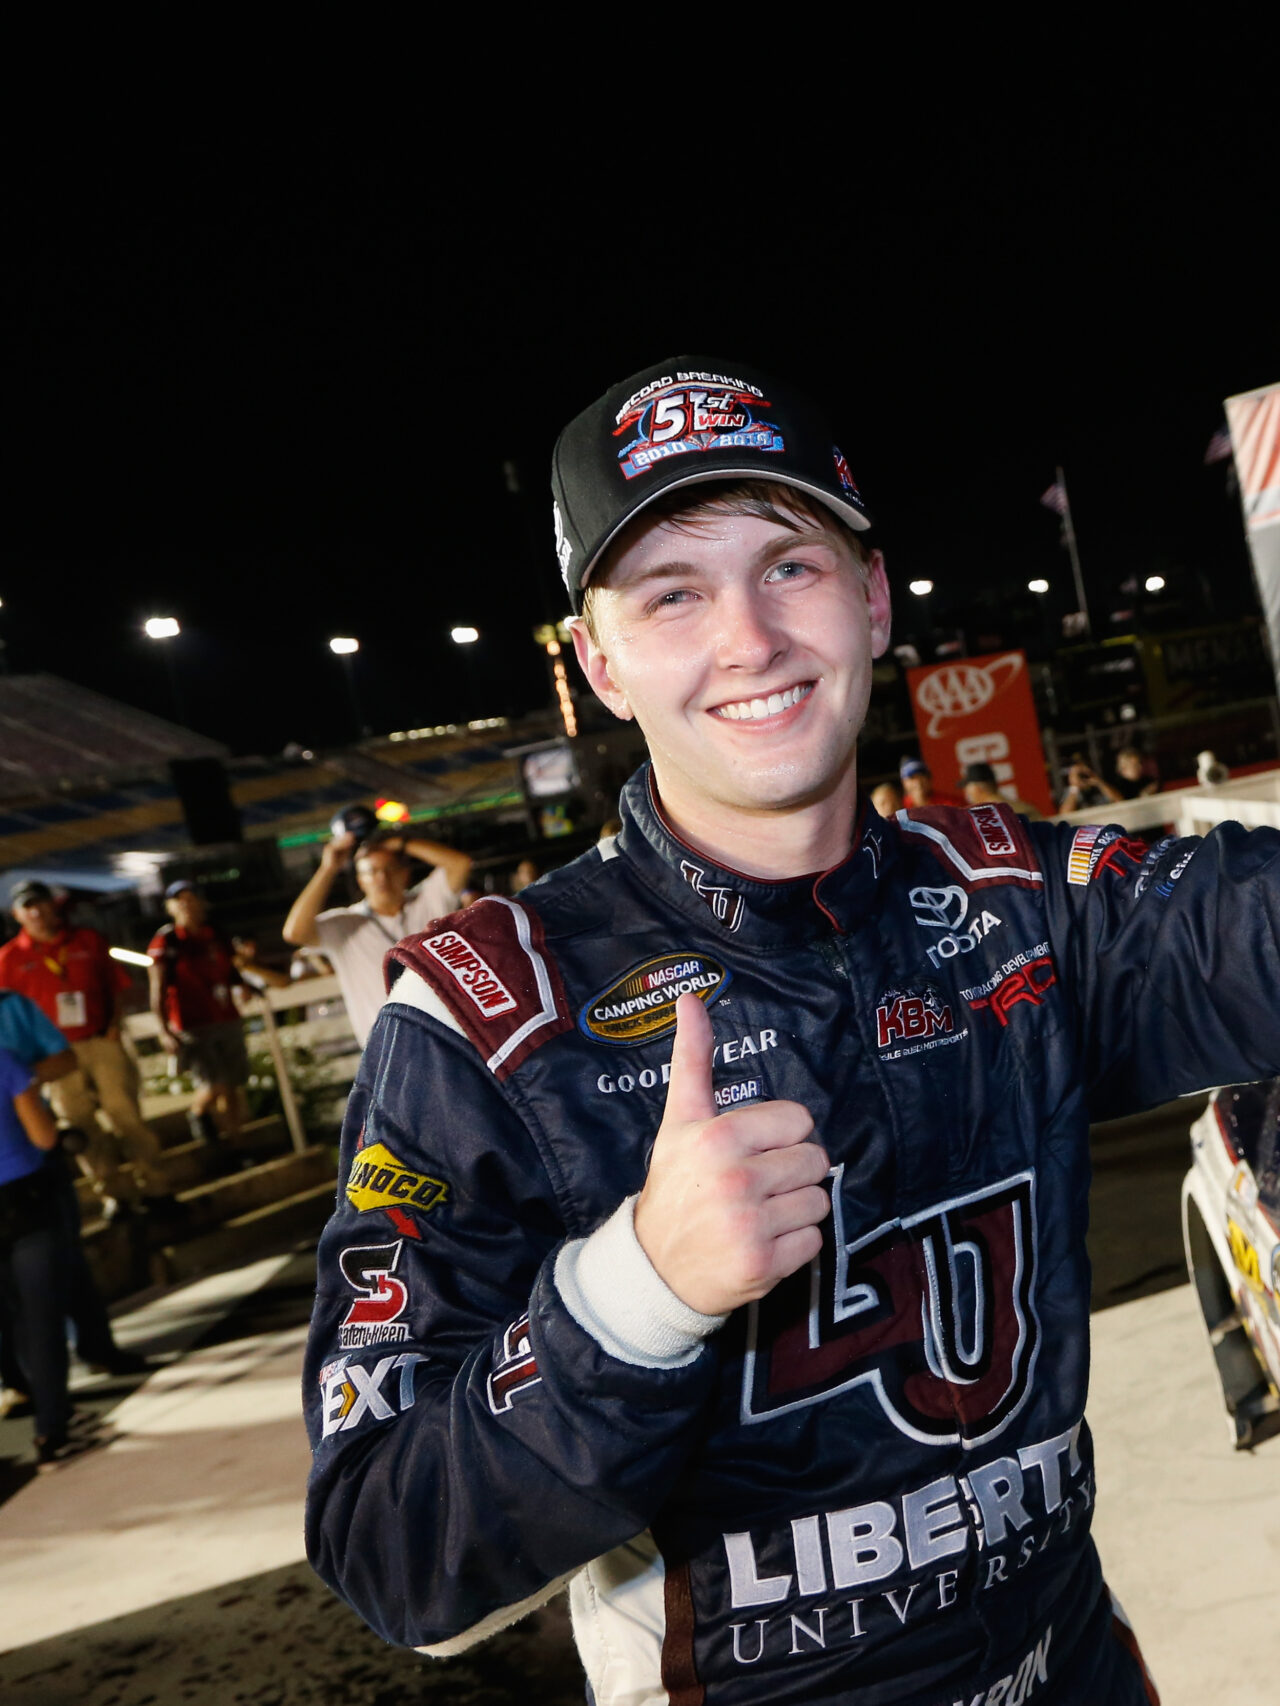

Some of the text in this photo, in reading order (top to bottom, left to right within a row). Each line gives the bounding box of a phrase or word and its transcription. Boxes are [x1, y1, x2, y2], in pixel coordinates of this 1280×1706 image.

[615, 371, 764, 425] RECORD BREAKING
[698, 413, 745, 427] WIN
[634, 441, 687, 466] 2010
[922, 664, 992, 713] AAA
[926, 910, 1002, 969] TOOTA
[429, 934, 510, 1011] SIMPSON
[594, 989, 664, 1020] CAMPING
[662, 972, 721, 999] WORLD
[648, 960, 700, 989] NASCAR
[876, 996, 954, 1048] KBM
[714, 1080, 757, 1106] ASCAR
[348, 1161, 443, 1206] UNOCO
[320, 1352, 431, 1440] EXT
[730, 1469, 1093, 1665] UNIVERSITY
